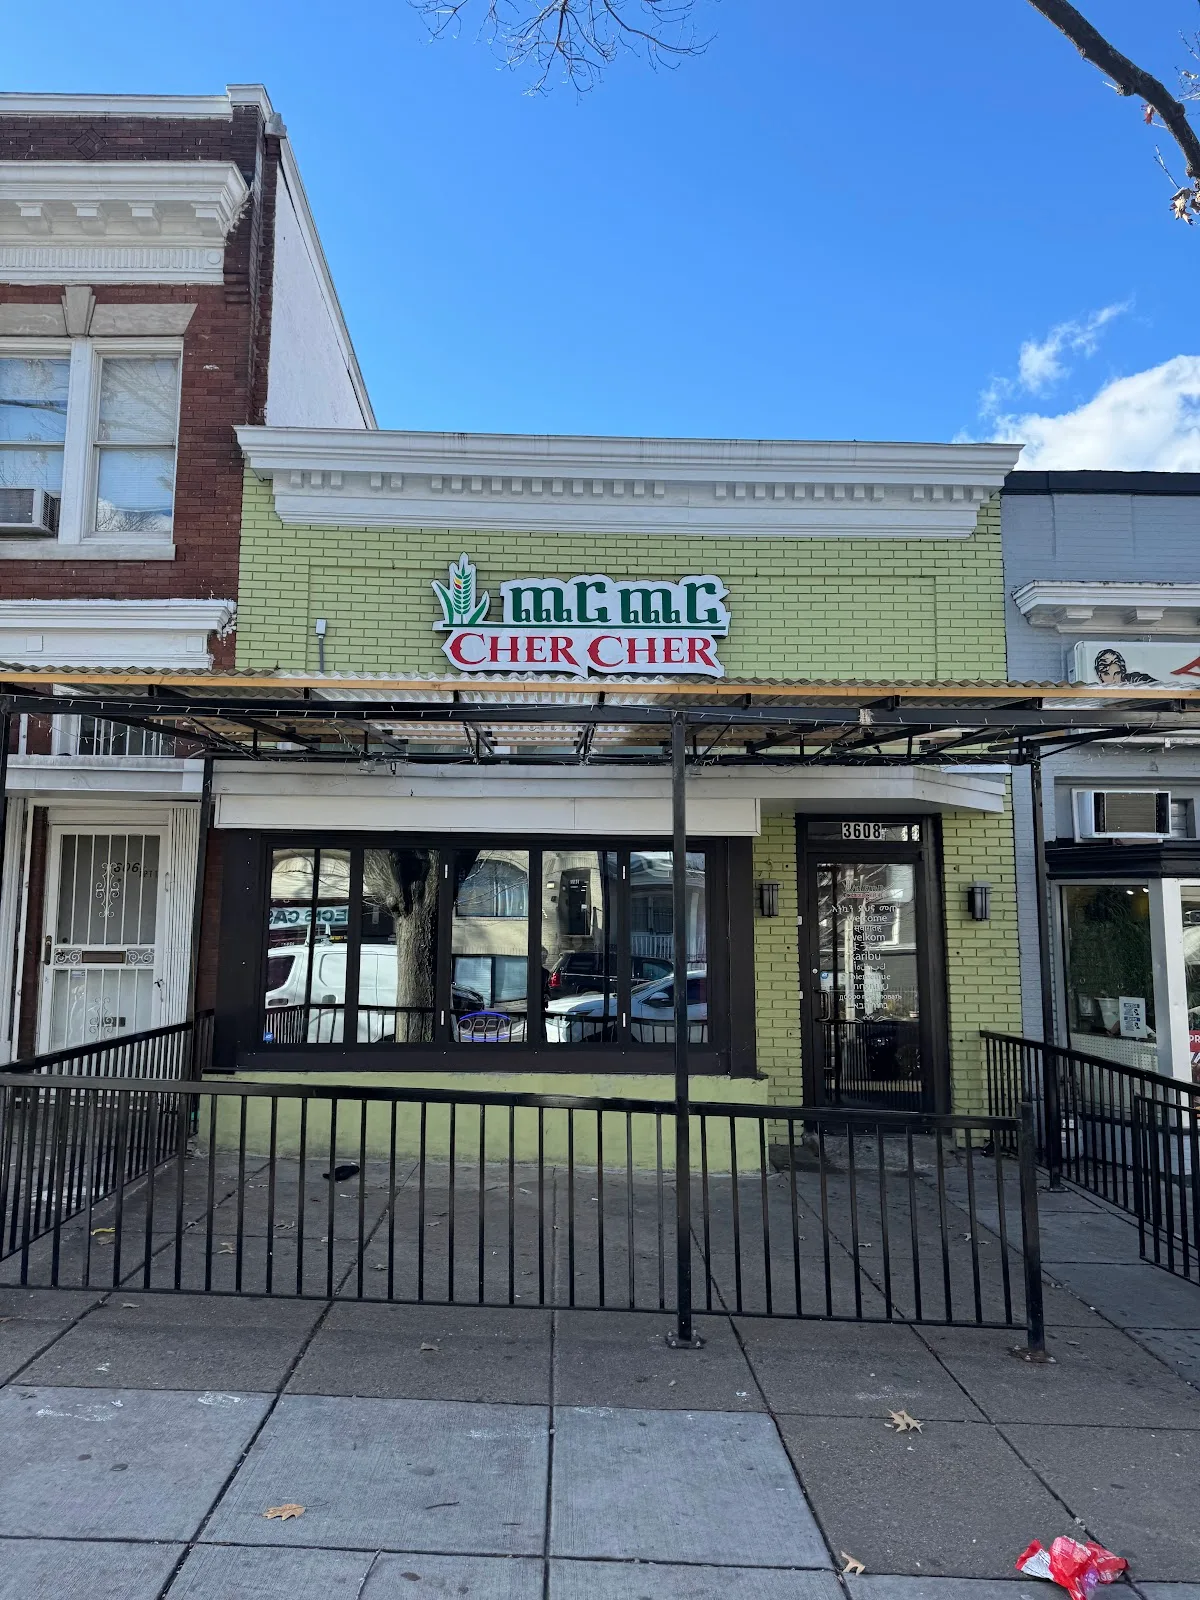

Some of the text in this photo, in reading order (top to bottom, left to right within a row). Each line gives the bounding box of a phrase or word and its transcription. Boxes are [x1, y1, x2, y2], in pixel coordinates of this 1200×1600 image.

[449, 632, 720, 670] CHER CHER
[843, 823, 881, 839] 3608
[457, 1018, 512, 1034] OPEN
